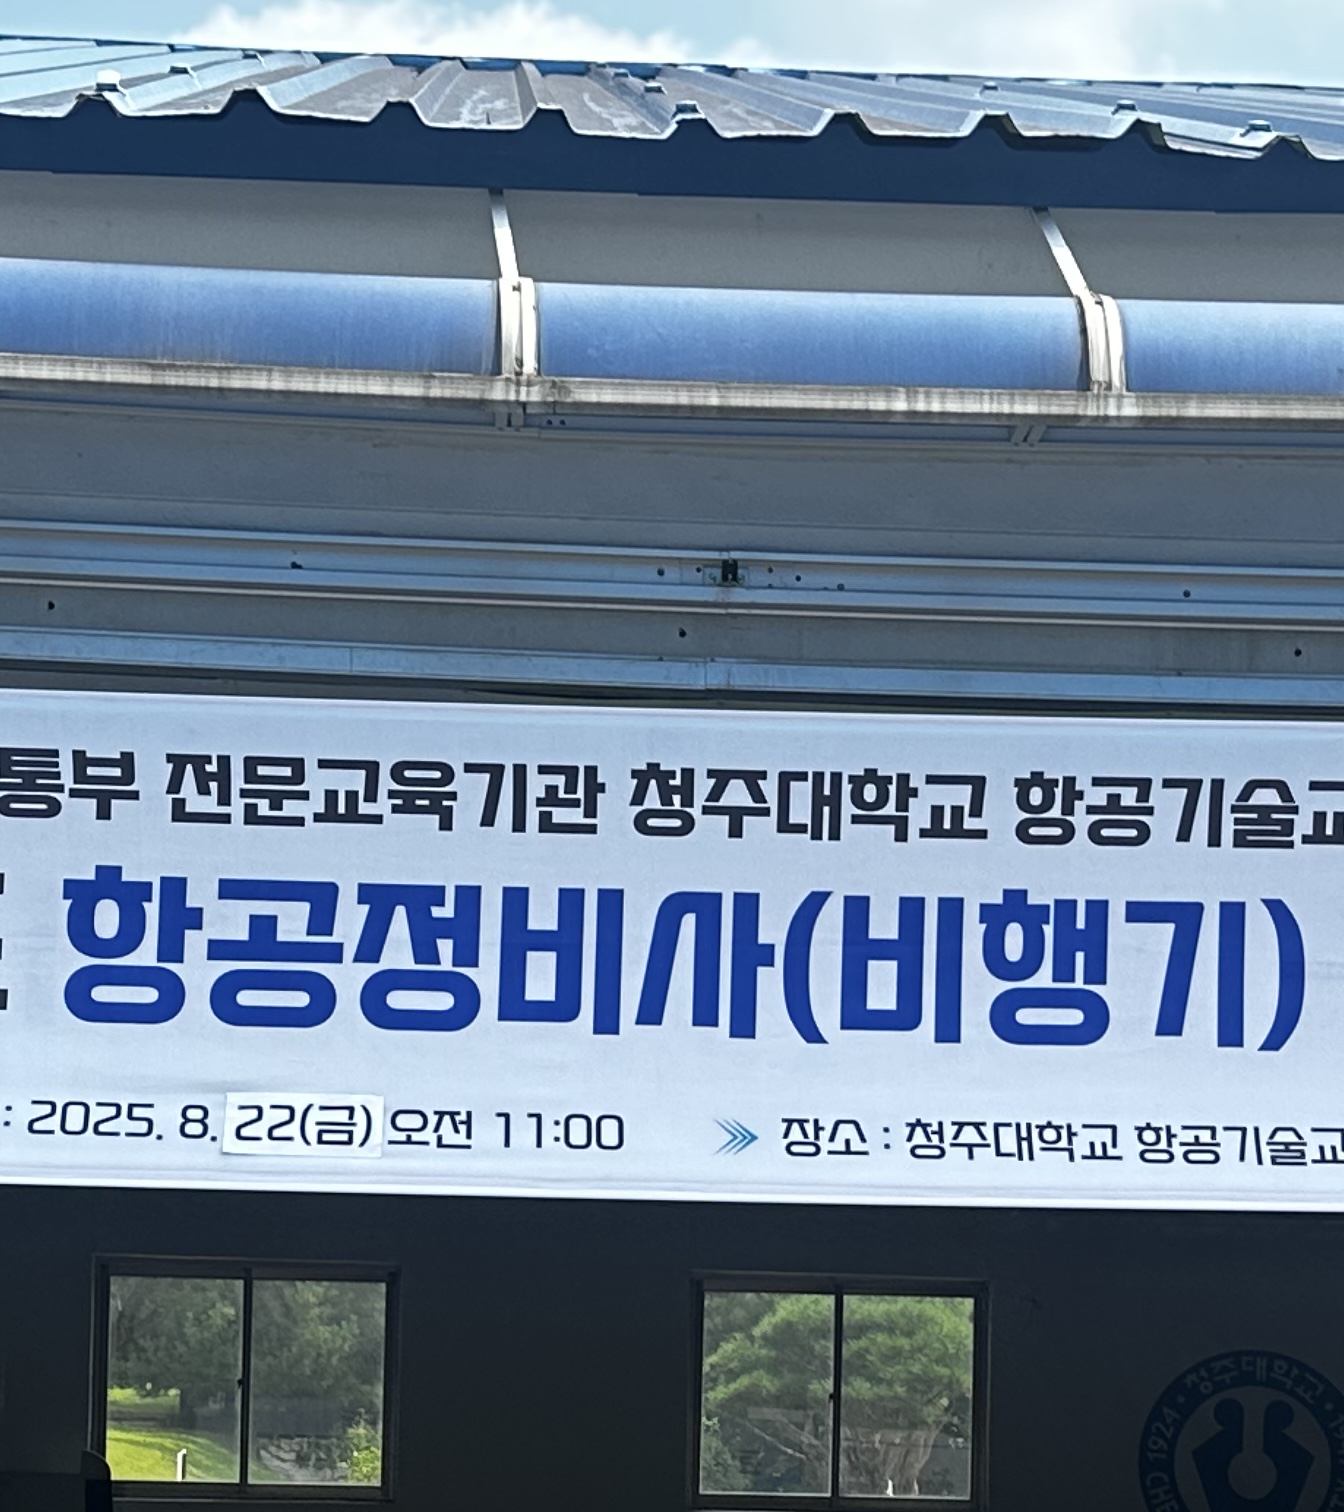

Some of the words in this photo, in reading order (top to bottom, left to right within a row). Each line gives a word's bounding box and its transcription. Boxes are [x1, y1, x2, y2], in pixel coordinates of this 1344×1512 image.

[166, 753, 606, 834] 전문교육기관
[629, 762, 988, 843] 청주대학교
[63, 865, 1305, 1051] 항공정비사(비행기)
[28, 1100, 163, 1140] 2025.
[180, 1105, 217, 1142] 8.
[236, 1104, 371, 1147] 22(금)
[388, 1110, 472, 1149] 오전
[496, 1112, 624, 1150] 11:00
[782, 1118, 869, 1157] 장소
[906, 1118, 1123, 1162] 청주대학교
[1185, 1357, 1324, 1405] 청주대학교
[1146, 1406, 1180, 1461] 1924
